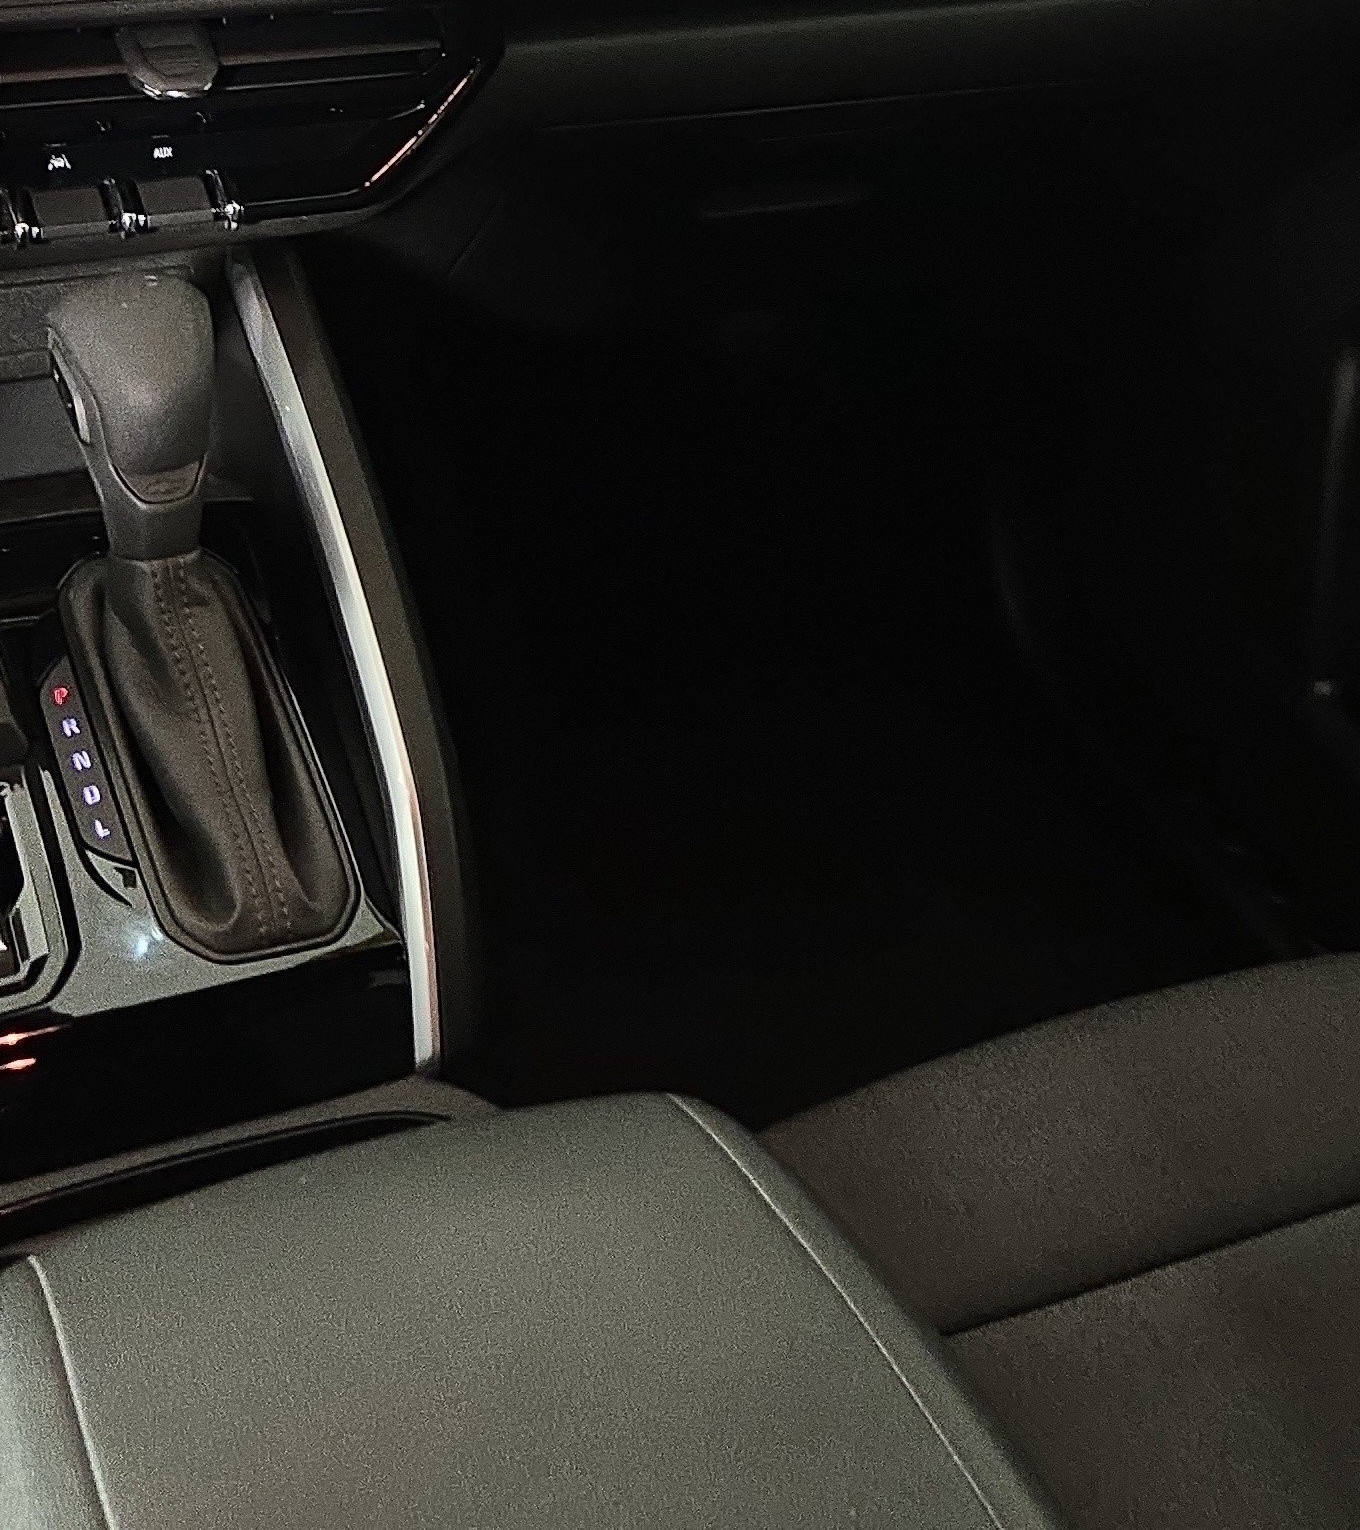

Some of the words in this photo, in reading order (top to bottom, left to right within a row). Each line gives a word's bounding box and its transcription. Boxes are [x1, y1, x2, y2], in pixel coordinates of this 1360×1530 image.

[153, 146, 173, 159] AUX
[54, 687, 68, 705] P
[61, 717, 81, 737] R
[71, 750, 92, 771] N
[83, 785, 101, 805] D
[94, 818, 110, 839] L
